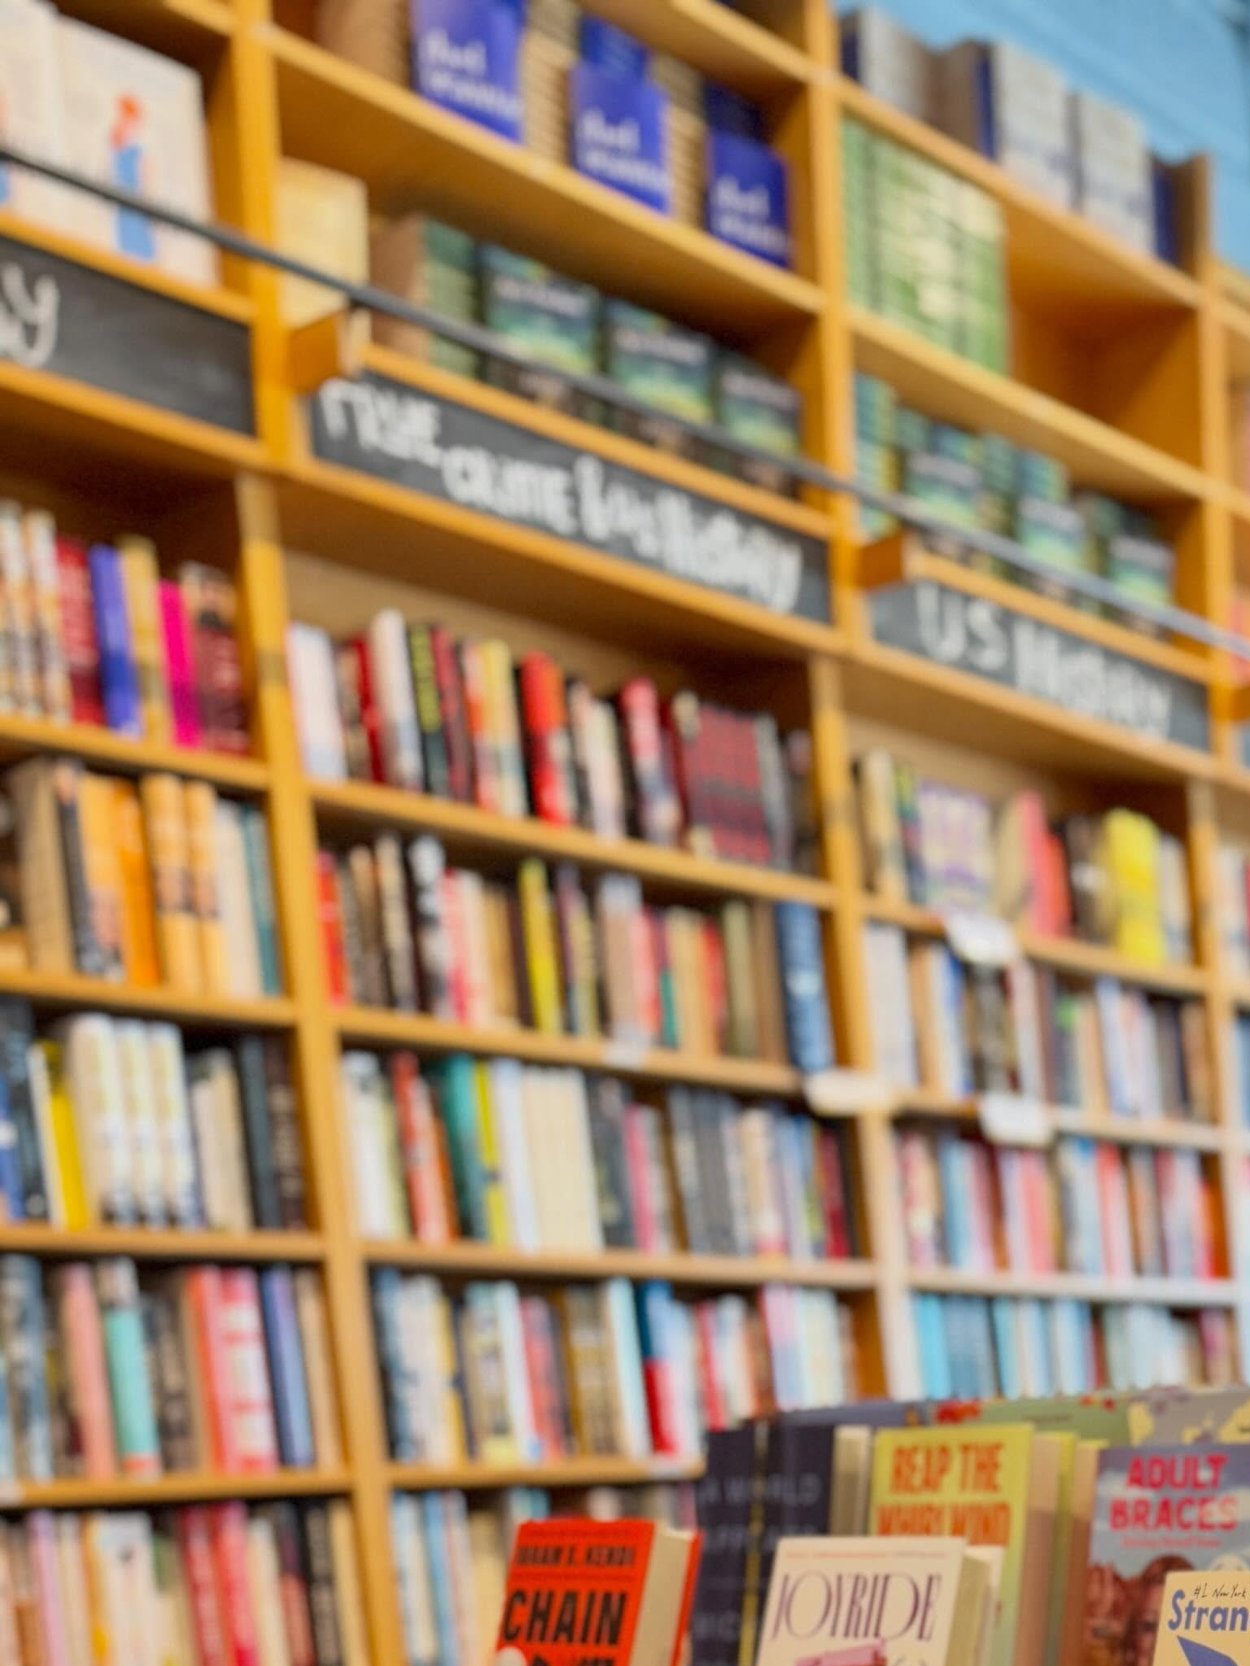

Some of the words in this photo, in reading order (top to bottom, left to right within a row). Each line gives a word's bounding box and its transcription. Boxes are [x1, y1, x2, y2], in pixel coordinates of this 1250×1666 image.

[889, 1443, 953, 1495] REAP
[959, 1441, 1003, 1493] THE
[1126, 1454, 1228, 1490] ADULT
[1108, 1496, 1239, 1532] BRACES
[769, 1570, 941, 1643] JOYRIDE
[1212, 1585, 1229, 1598] New
[1230, 1584, 1247, 1598] York
[503, 1588, 627, 1647] CHAIN
